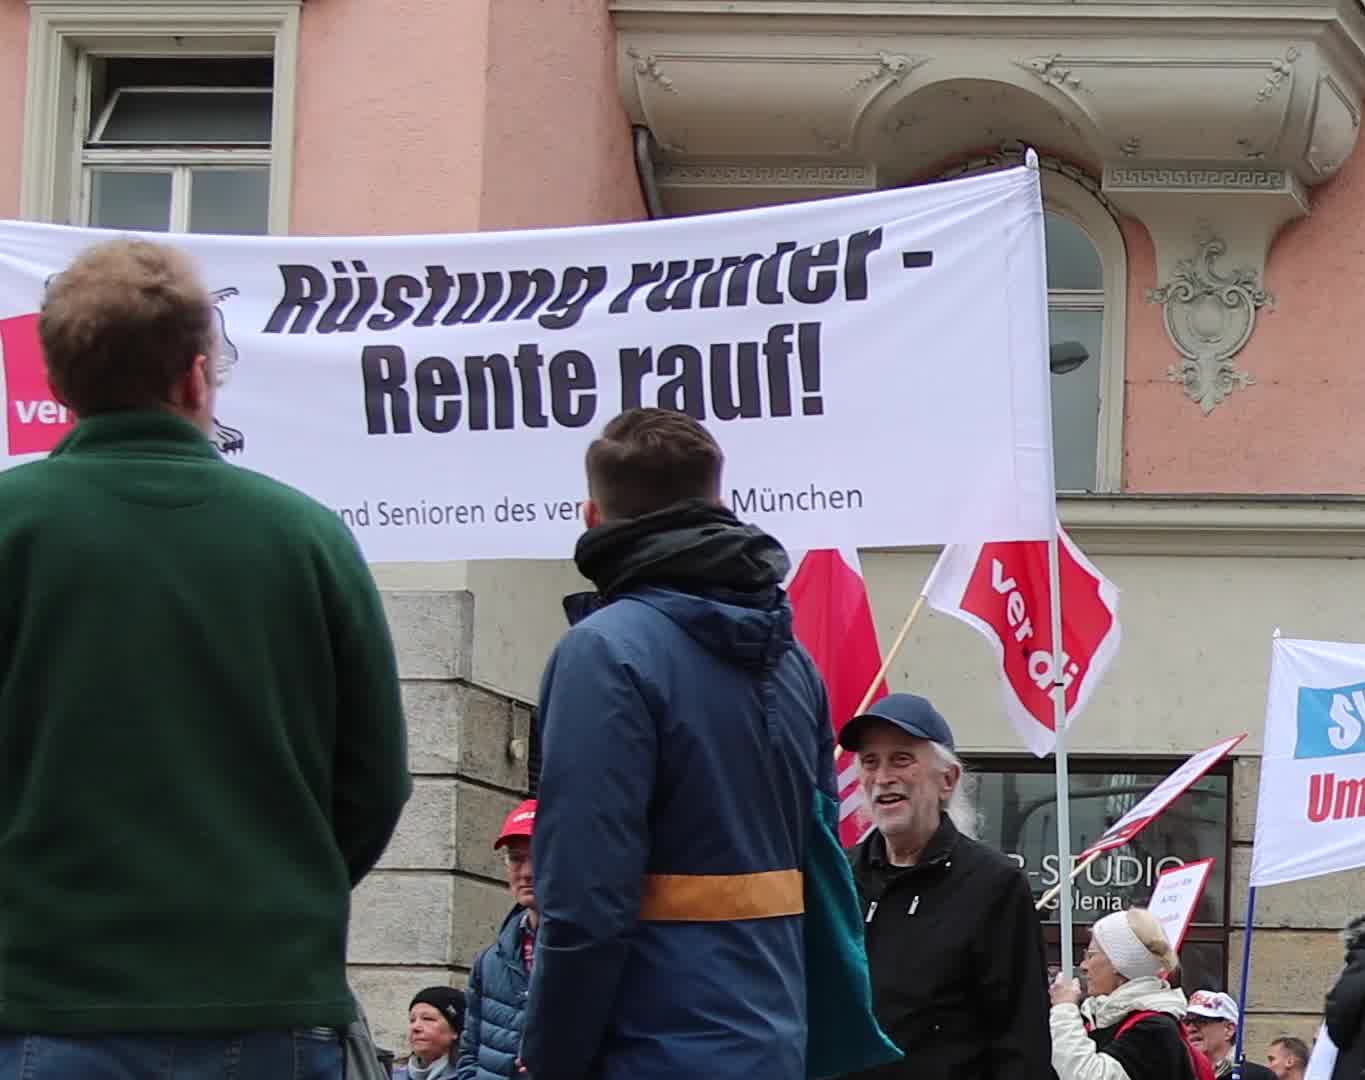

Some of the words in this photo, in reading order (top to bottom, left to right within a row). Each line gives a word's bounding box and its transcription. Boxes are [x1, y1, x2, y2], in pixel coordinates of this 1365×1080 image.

[261, 258, 608, 335] Rüstung
[608, 226, 884, 314] runter
[361, 343, 598, 436] Rente
[617, 321, 825, 422] rauf!
[338, 500, 370, 527] nd
[378, 499, 485, 527] Senioren
[494, 495, 537, 523] des
[730, 484, 864, 515] München
[1040, 889, 1123, 911] Glenia
